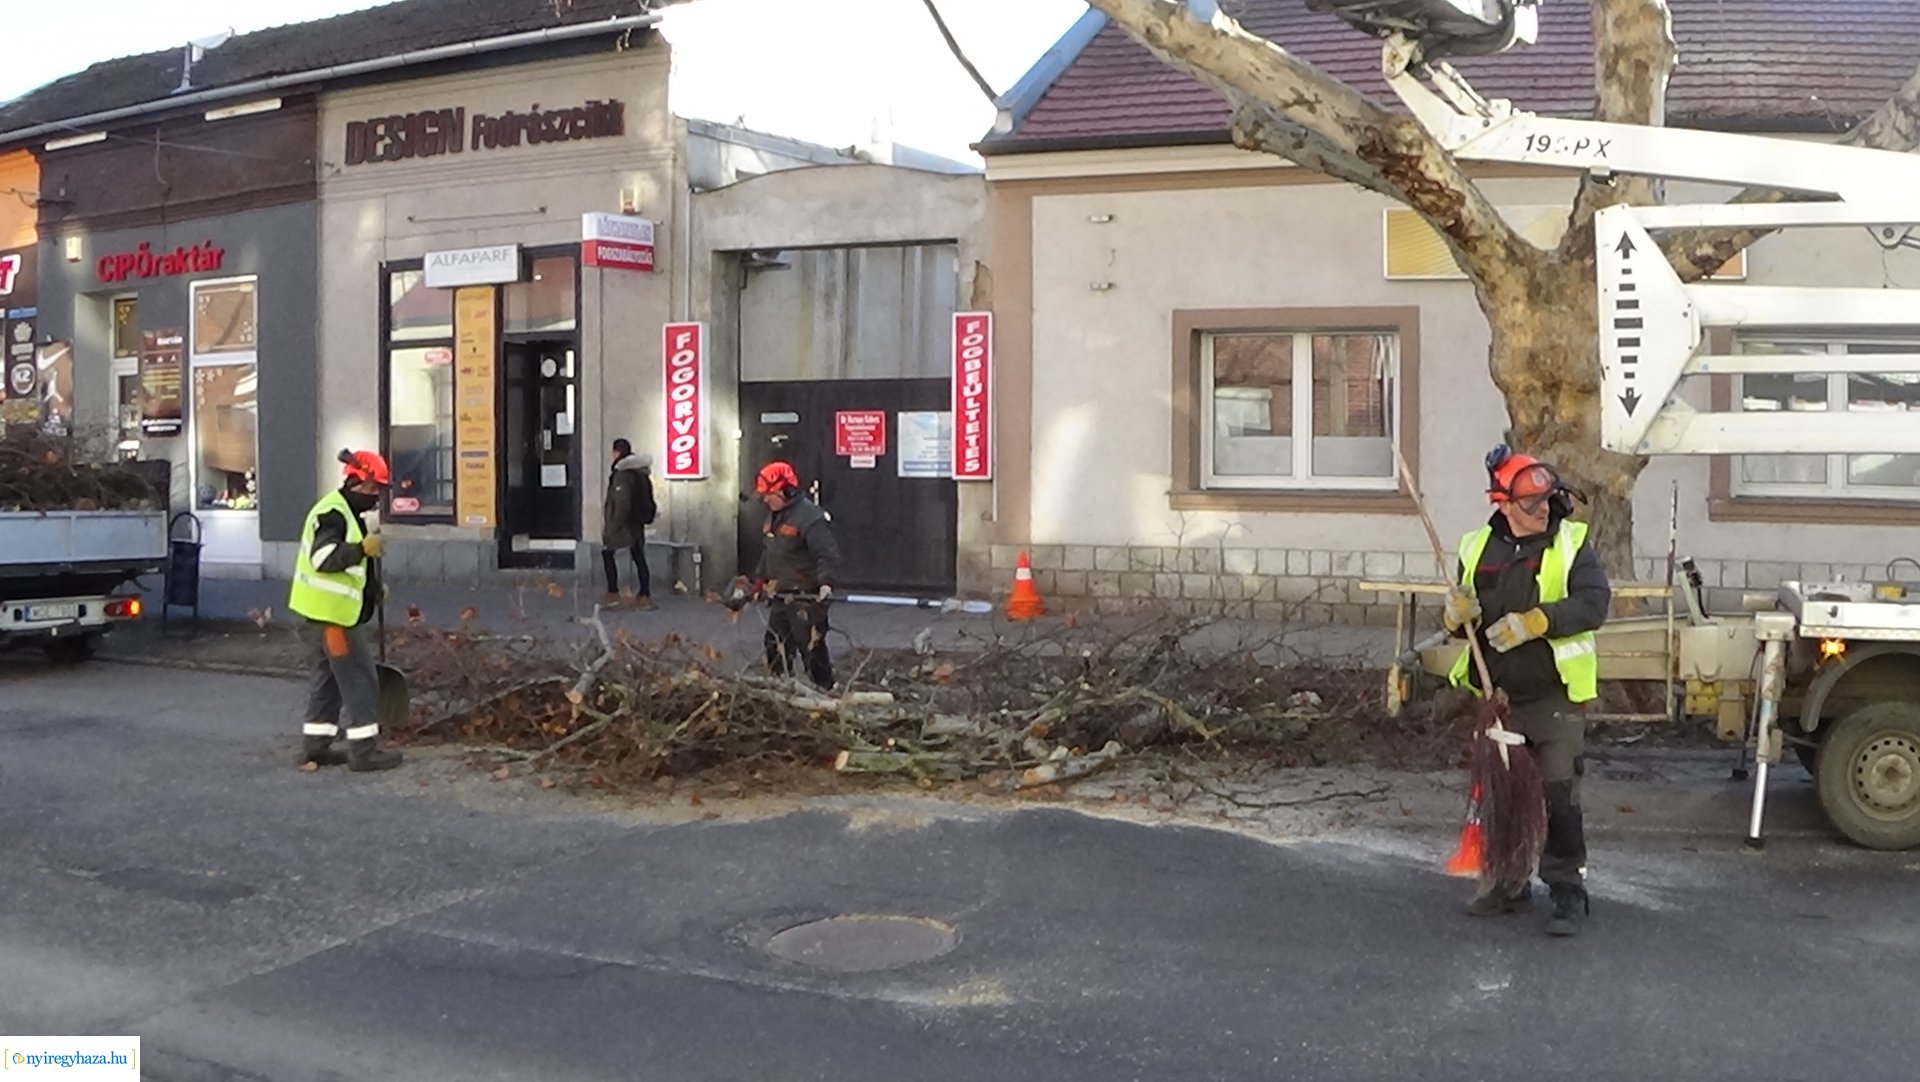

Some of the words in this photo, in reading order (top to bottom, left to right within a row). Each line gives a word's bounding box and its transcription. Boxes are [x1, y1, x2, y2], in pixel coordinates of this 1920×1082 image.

[345, 107, 465, 165] DESIGN
[97, 240, 225, 282] CIPŐraktár
[431, 248, 511, 267] ALFAPARF
[671, 332, 696, 471] FOGORVOS
